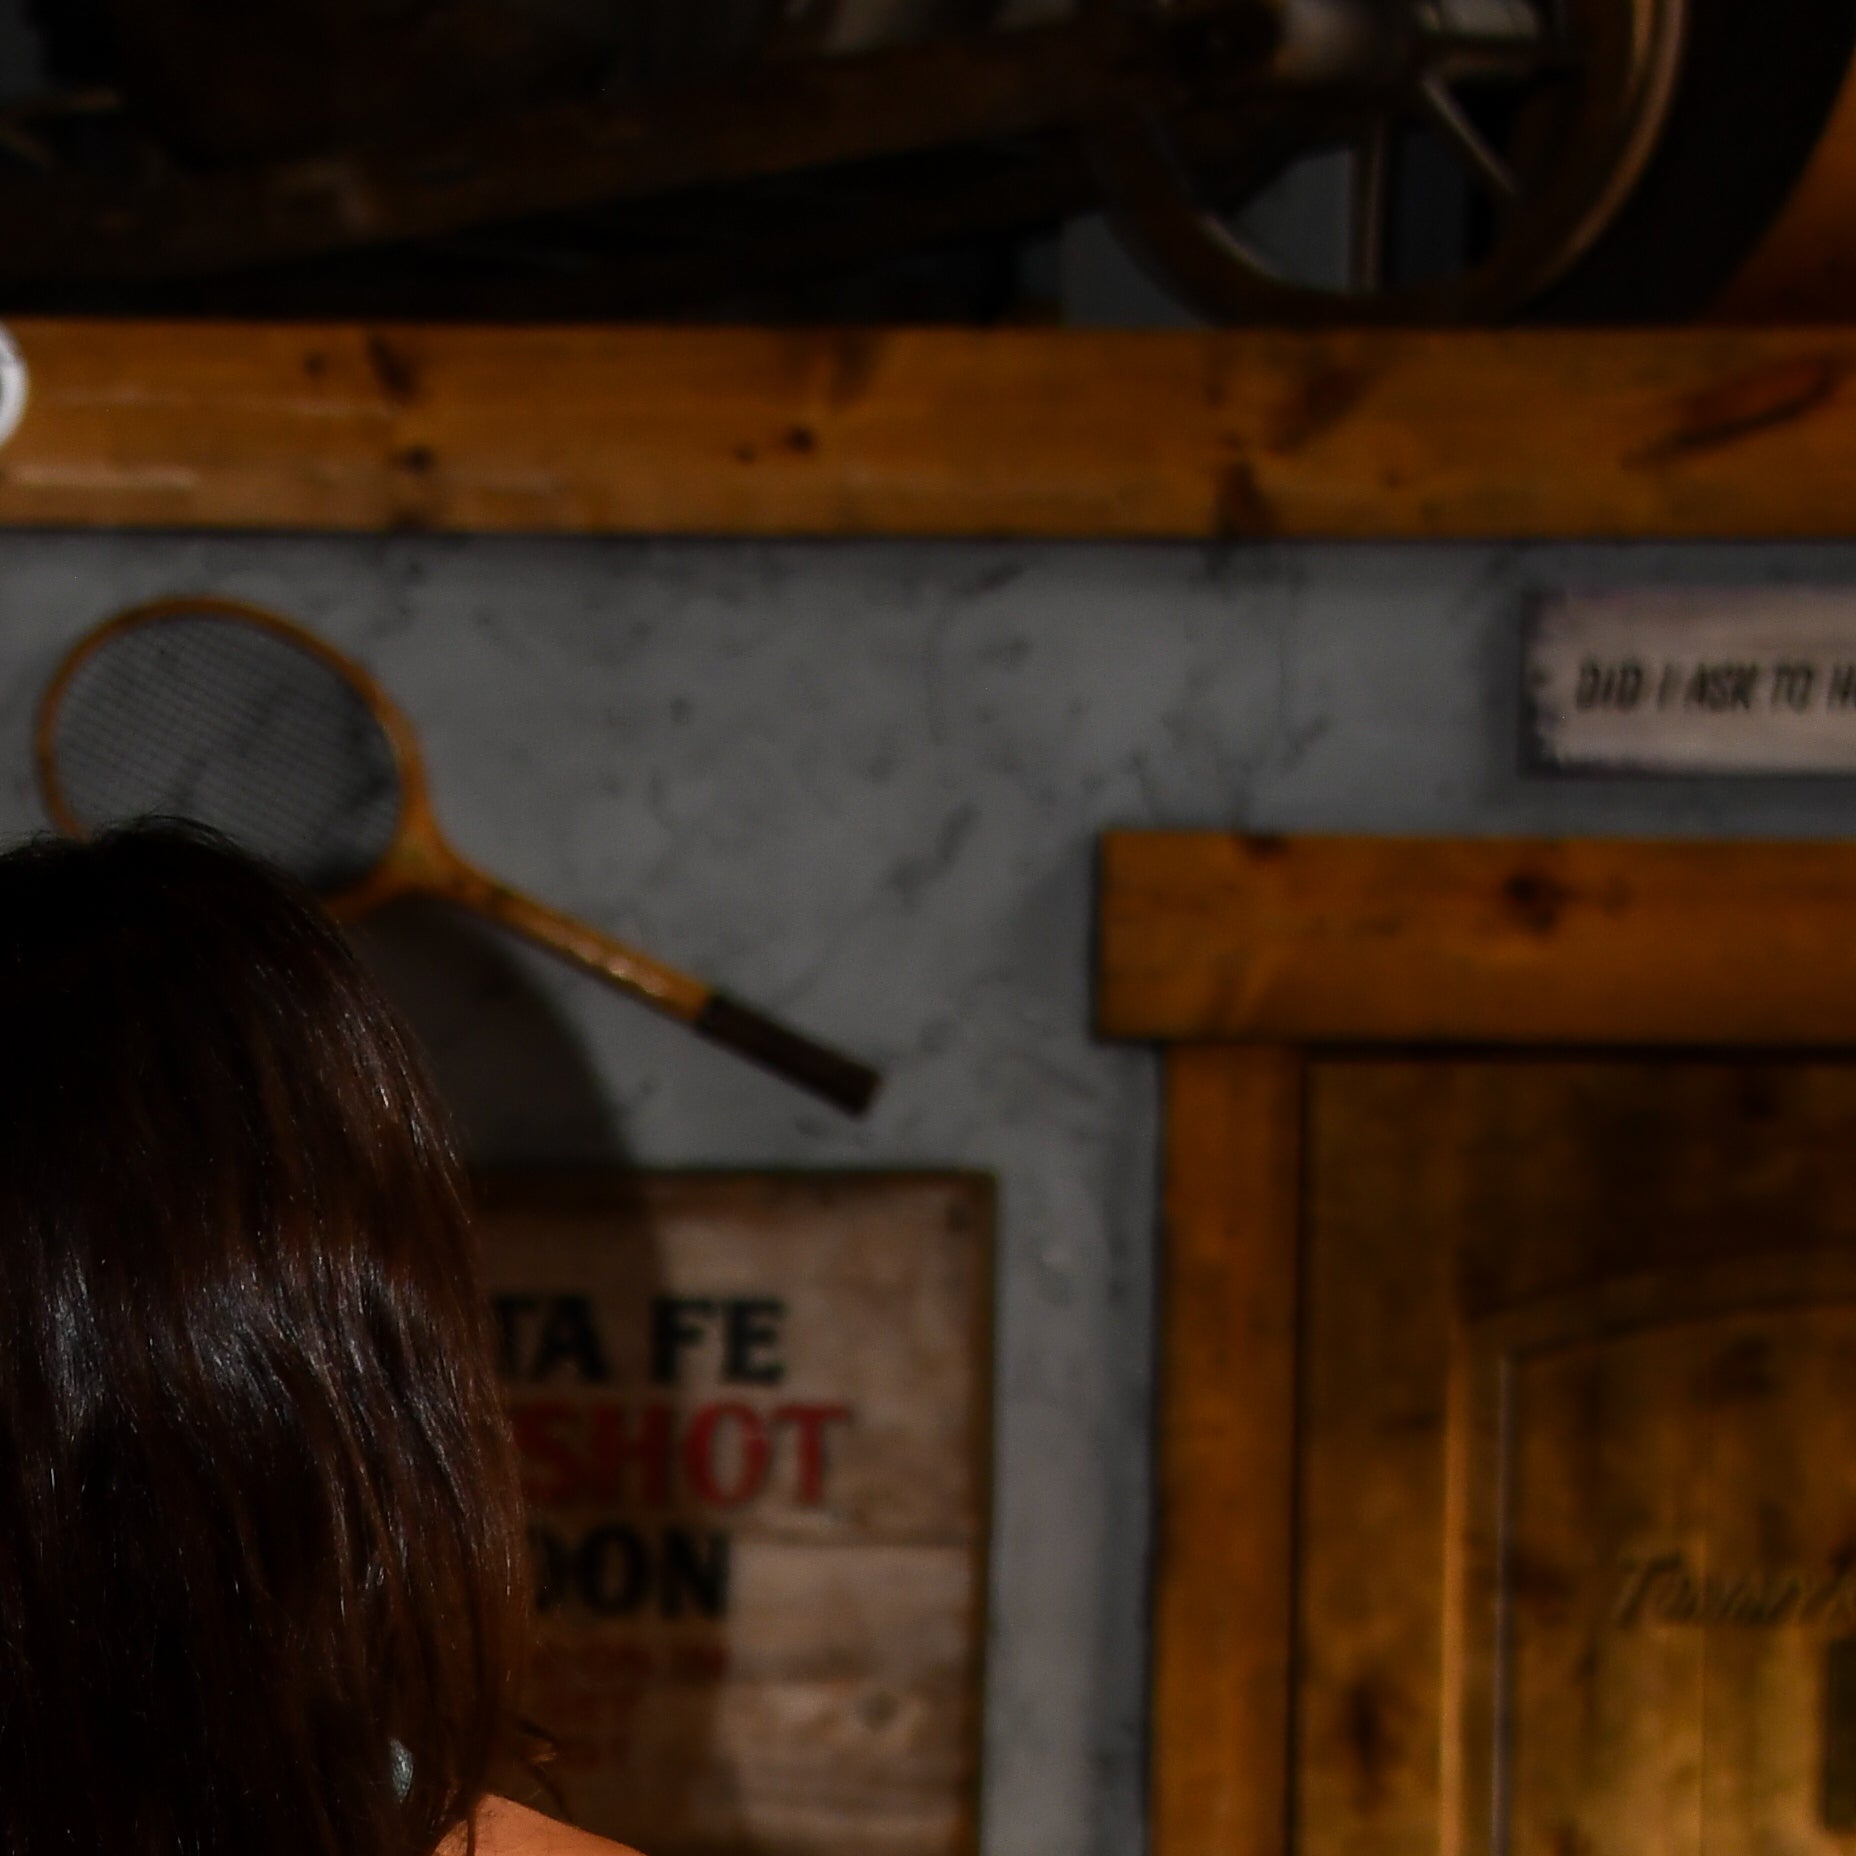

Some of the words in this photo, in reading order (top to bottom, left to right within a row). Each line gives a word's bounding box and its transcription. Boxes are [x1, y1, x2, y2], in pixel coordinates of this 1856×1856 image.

[1576, 661, 1643, 714] DID
[1657, 663, 1677, 712] I
[1685, 661, 1760, 714] ASK
[1770, 661, 1817, 714] TO
[656, 1296, 786, 1383] FE
